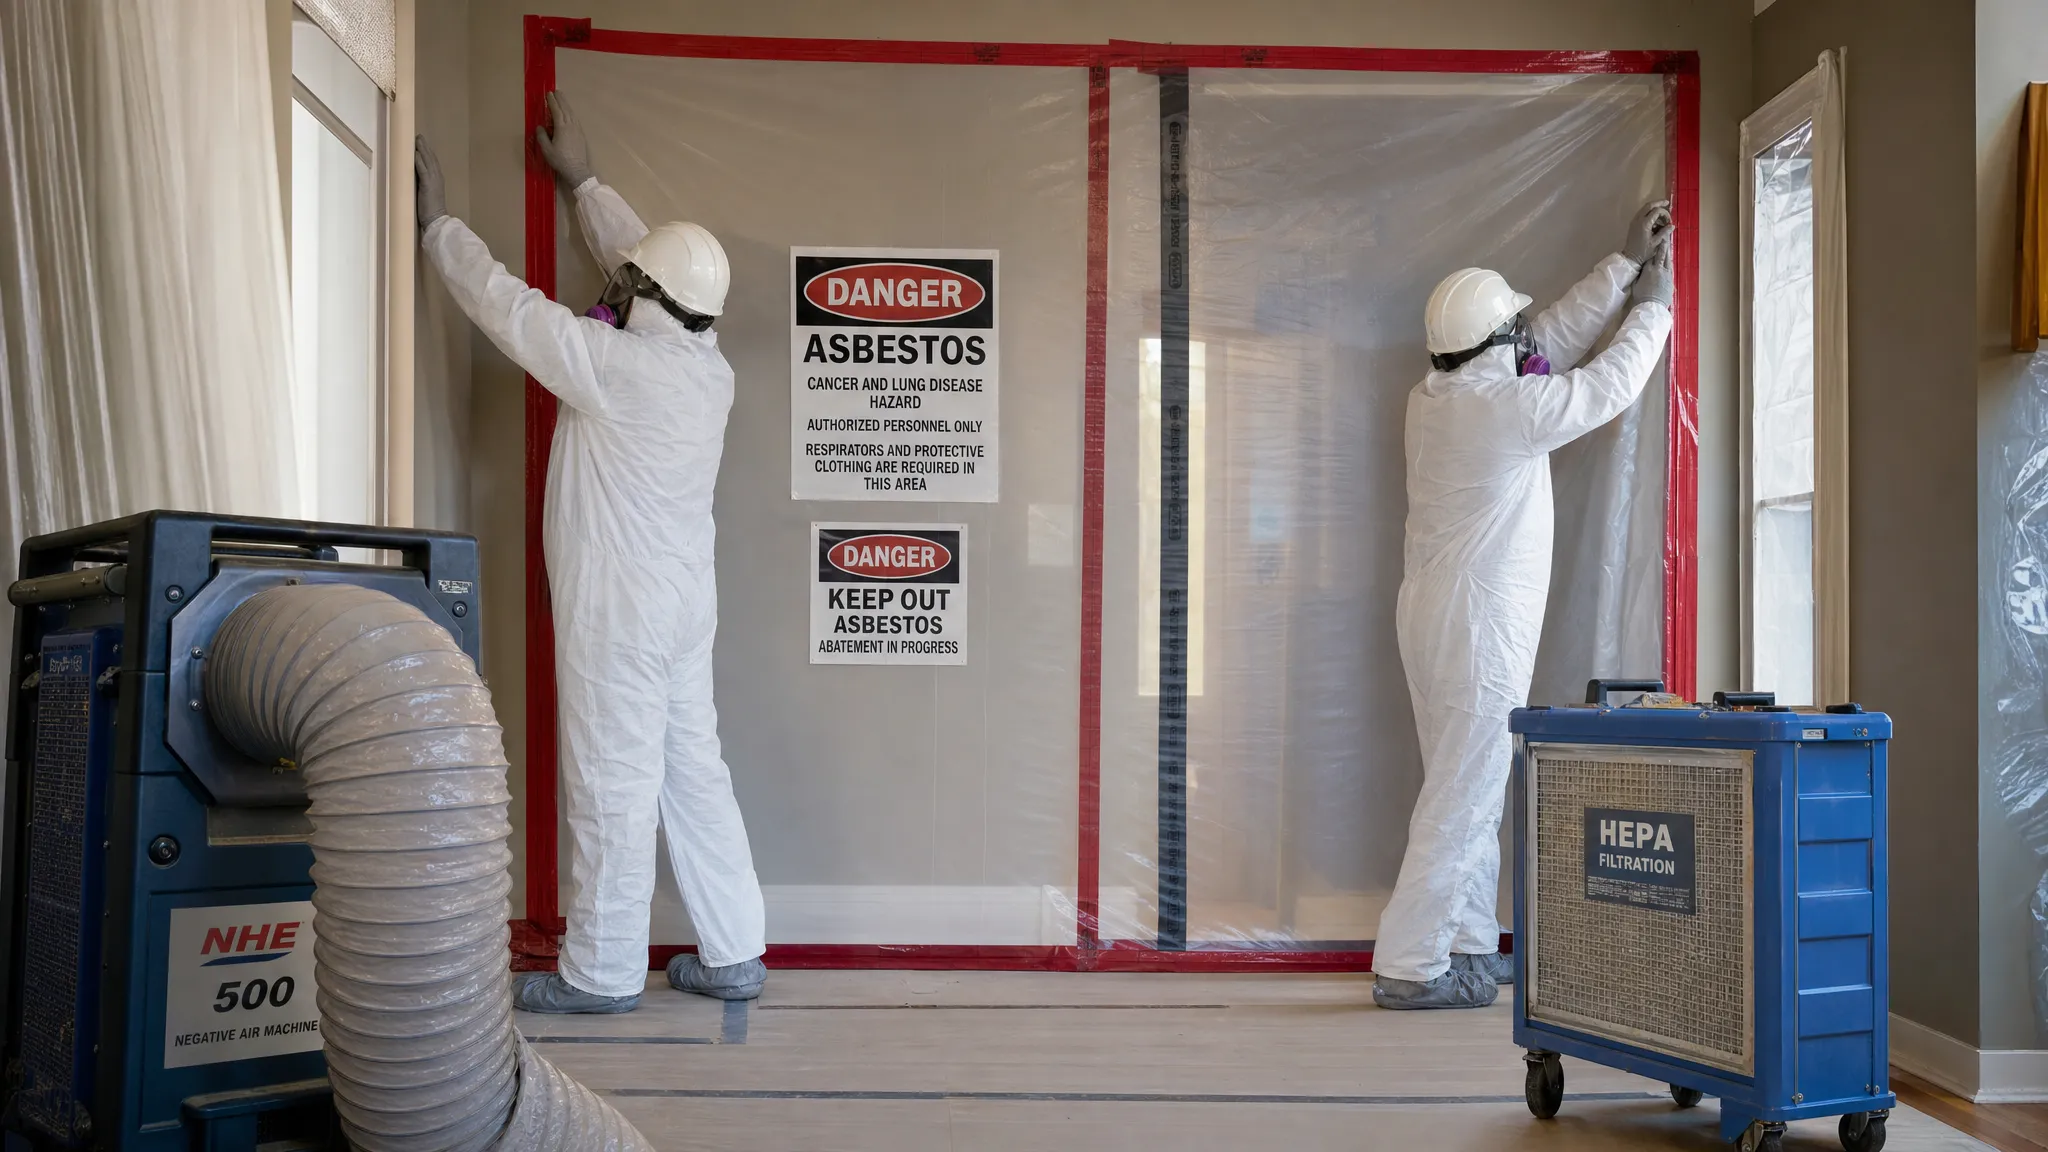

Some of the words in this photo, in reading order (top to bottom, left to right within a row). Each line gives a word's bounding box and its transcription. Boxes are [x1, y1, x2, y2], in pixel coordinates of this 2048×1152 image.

[827, 277, 962, 308] DANGER
[803, 333, 986, 365] ASBESTOS
[807, 377, 858, 391] CANCER
[862, 378, 888, 391] AND
[892, 378, 926, 391] LUNG
[930, 379, 983, 392] DISEASE
[870, 396, 921, 409] HAZARD
[807, 419, 880, 431] AUTHORIZED
[883, 420, 951, 432] PERSONNEL
[954, 421, 982, 433] ONLY
[806, 443, 884, 456] RESPIRATORS
[887, 445, 911, 457] AND
[914, 445, 984, 457] PROTECTIVE
[815, 460, 872, 473] CLOTHING
[875, 461, 897, 473] ARE
[901, 461, 959, 475] REQUIRED
[963, 462, 974, 474] IN
[864, 477, 891, 490] THIS
[895, 478, 927, 490] AREA
[843, 545, 935, 567] DANGER
[829, 588, 894, 610] KEEP
[901, 589, 950, 610] OUT
[834, 615, 943, 634] ASBESTOS
[819, 640, 884, 653] ABATEMENT
[887, 641, 898, 653] IN
[901, 641, 958, 654] PROGRESS
[1600, 820, 1674, 852] HEPA
[1599, 853, 1674, 875] FILTRATION
[200, 922, 300, 954] NHE
[213, 976, 295, 1013] 500
[175, 1029, 236, 1047] NEGATIVE
[240, 1027, 260, 1039] AIR
[264, 1020, 318, 1037] MACHINE
